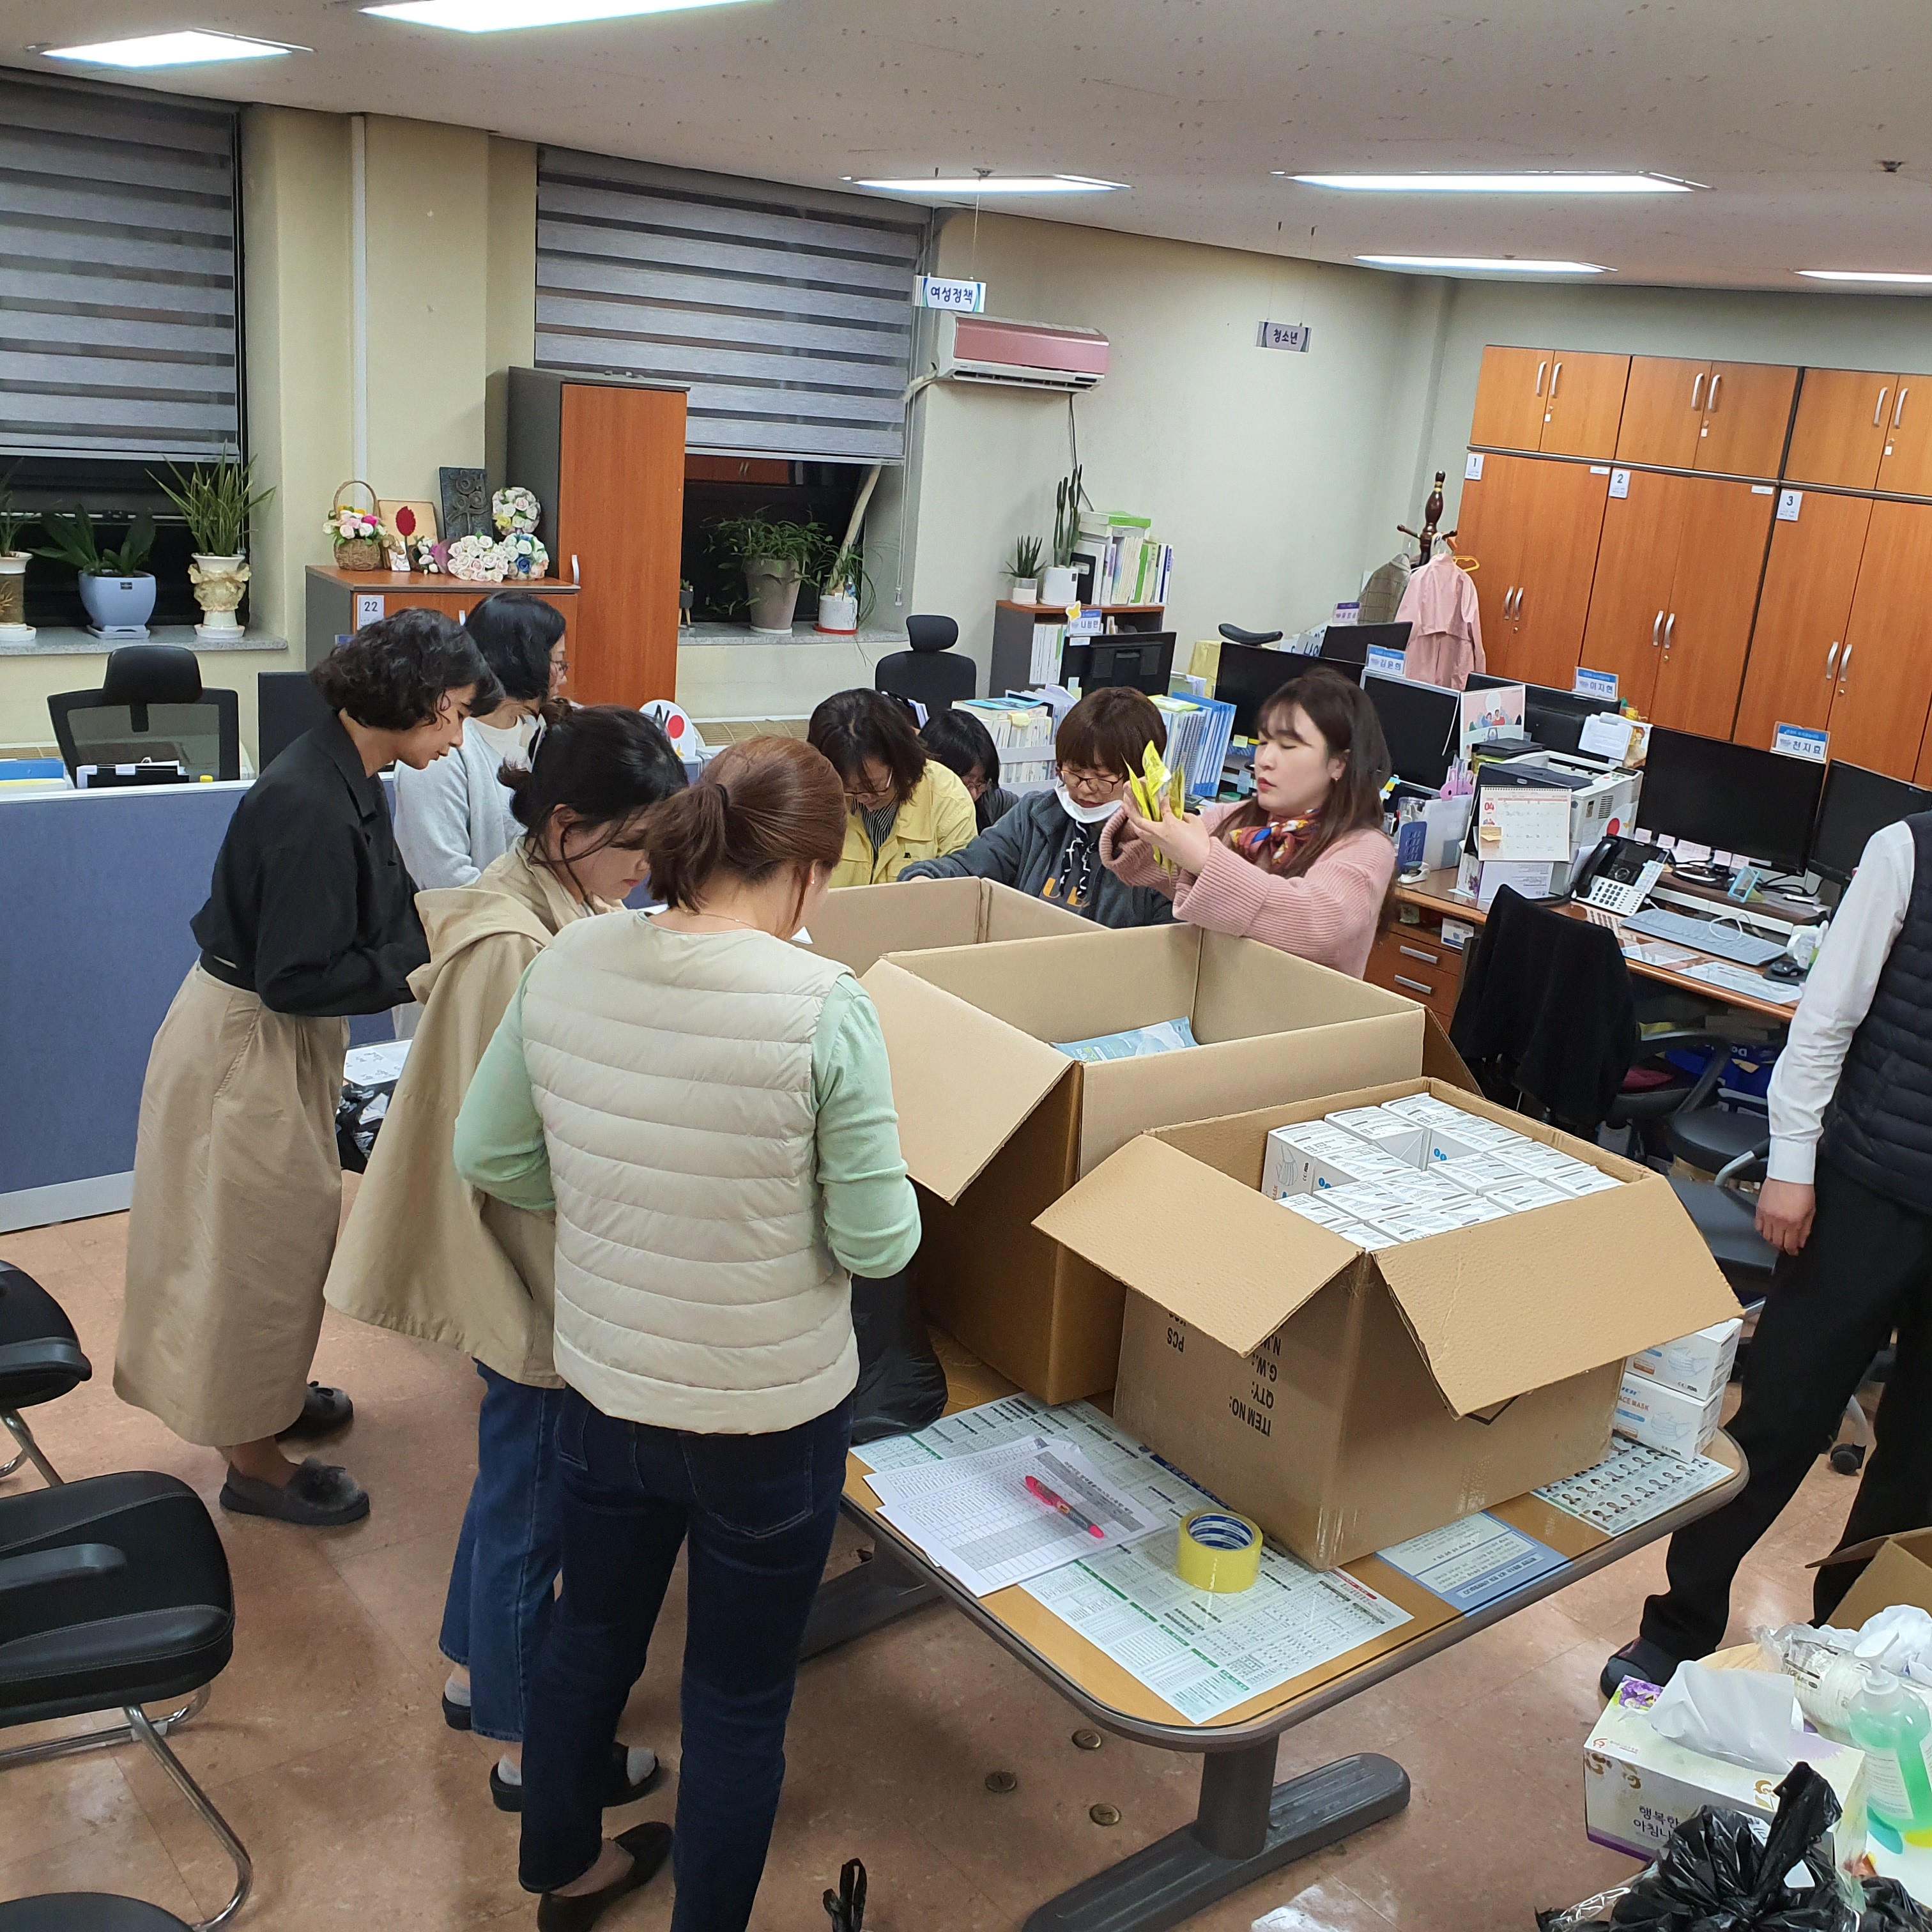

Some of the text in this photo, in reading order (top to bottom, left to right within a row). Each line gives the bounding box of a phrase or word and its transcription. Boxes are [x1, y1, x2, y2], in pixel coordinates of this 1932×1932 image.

[930, 286, 973, 304] 여성정책
[1273, 328, 1298, 345] 청소년
[1473, 458, 1477, 467] 1
[1617, 473, 1623, 484] 2
[1786, 495, 1793, 506] 3
[364, 601, 378, 612] 22
[1484, 802, 1494, 811] 04
[1167, 1327, 1185, 1353] PCS
[1252, 1353, 1278, 1383] G.W.:
[1250, 1381, 1275, 1409] QTY:
[1618, 1395, 1650, 1411] ACE MASK
[1229, 1395, 1271, 1437] ITEM NO:
[1639, 1805, 1680, 1829] 행복한
[1633, 1819, 1675, 1841] 아침나
